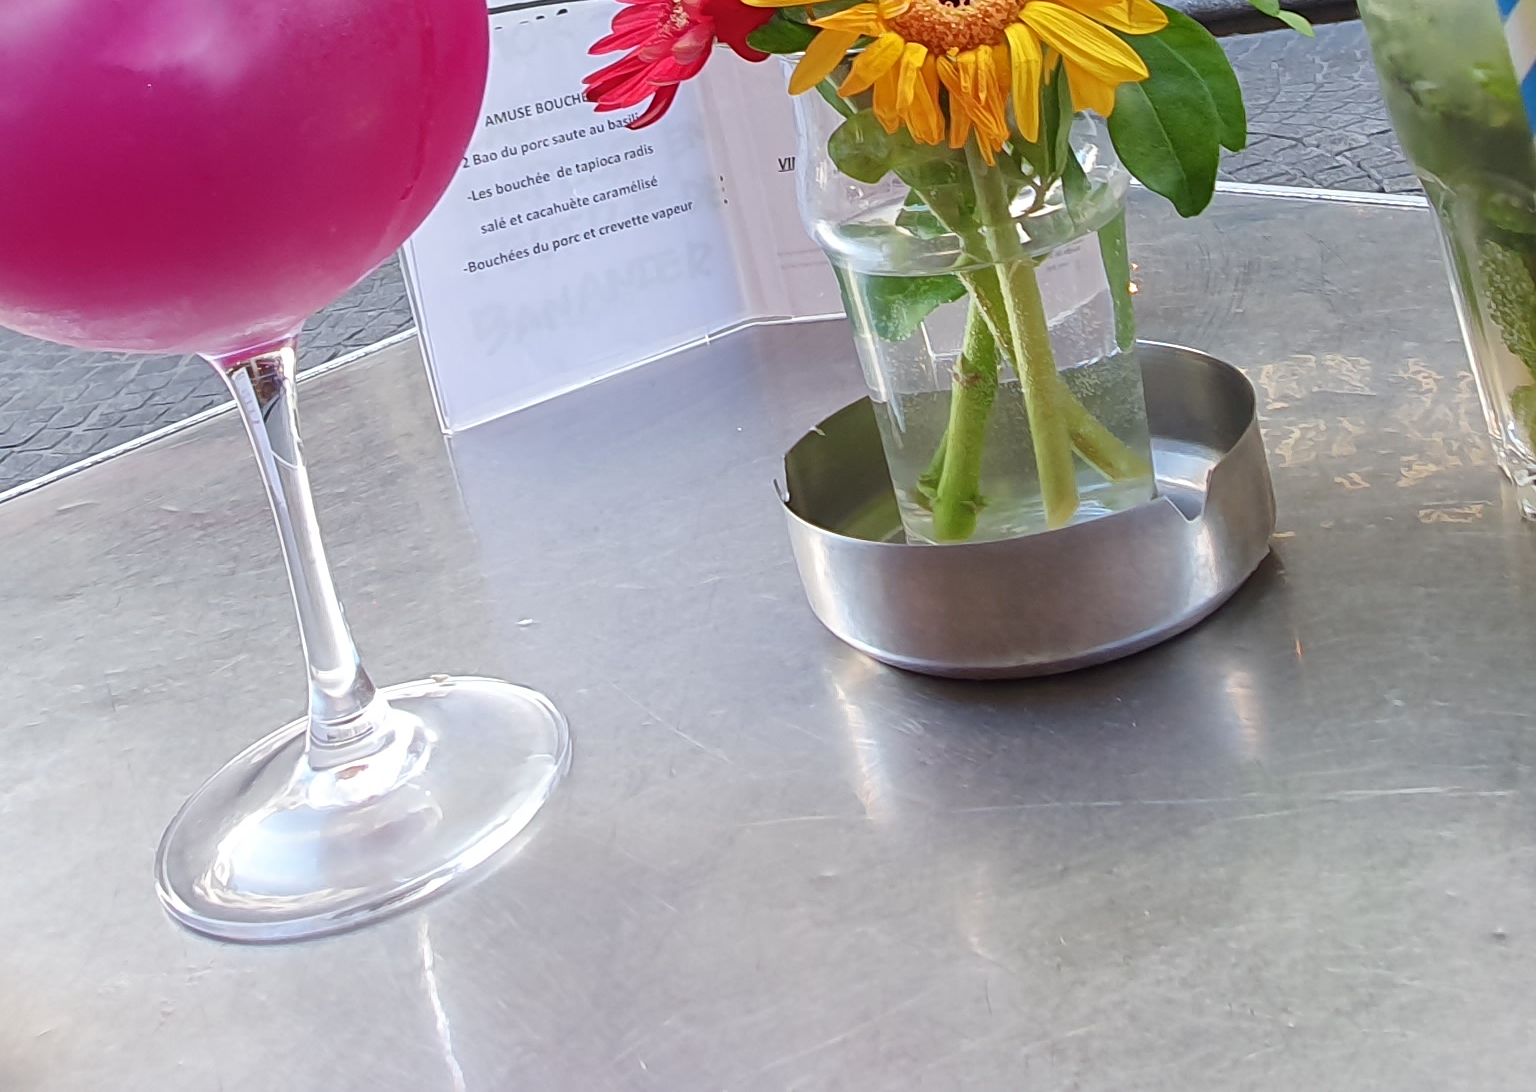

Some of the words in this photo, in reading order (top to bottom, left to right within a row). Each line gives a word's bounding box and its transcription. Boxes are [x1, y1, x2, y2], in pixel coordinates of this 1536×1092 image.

[473, 151, 498, 166] Bao
[501, 145, 517, 159] du
[521, 138, 549, 155] porc
[552, 129, 586, 146] saute
[590, 123, 605, 135] au
[485, 105, 532, 127] AMUSE
[467, 187, 493, 201] -Les
[495, 171, 550, 194] bouchée
[557, 165, 572, 178] de
[576, 153, 621, 174] tapioca
[624, 143, 654, 160] radis
[480, 216, 507, 234] salé
[509, 213, 524, 227] et
[526, 197, 589, 222] cacahuète
[592, 176, 658, 203] caramélisé
[463, 247, 530, 273] -Bouchées
[532, 240, 549, 255] du
[552, 233, 581, 251] porc
[583, 227, 596, 240] et
[599, 212, 649, 236] crevette
[651, 201, 693, 221] vapeur
